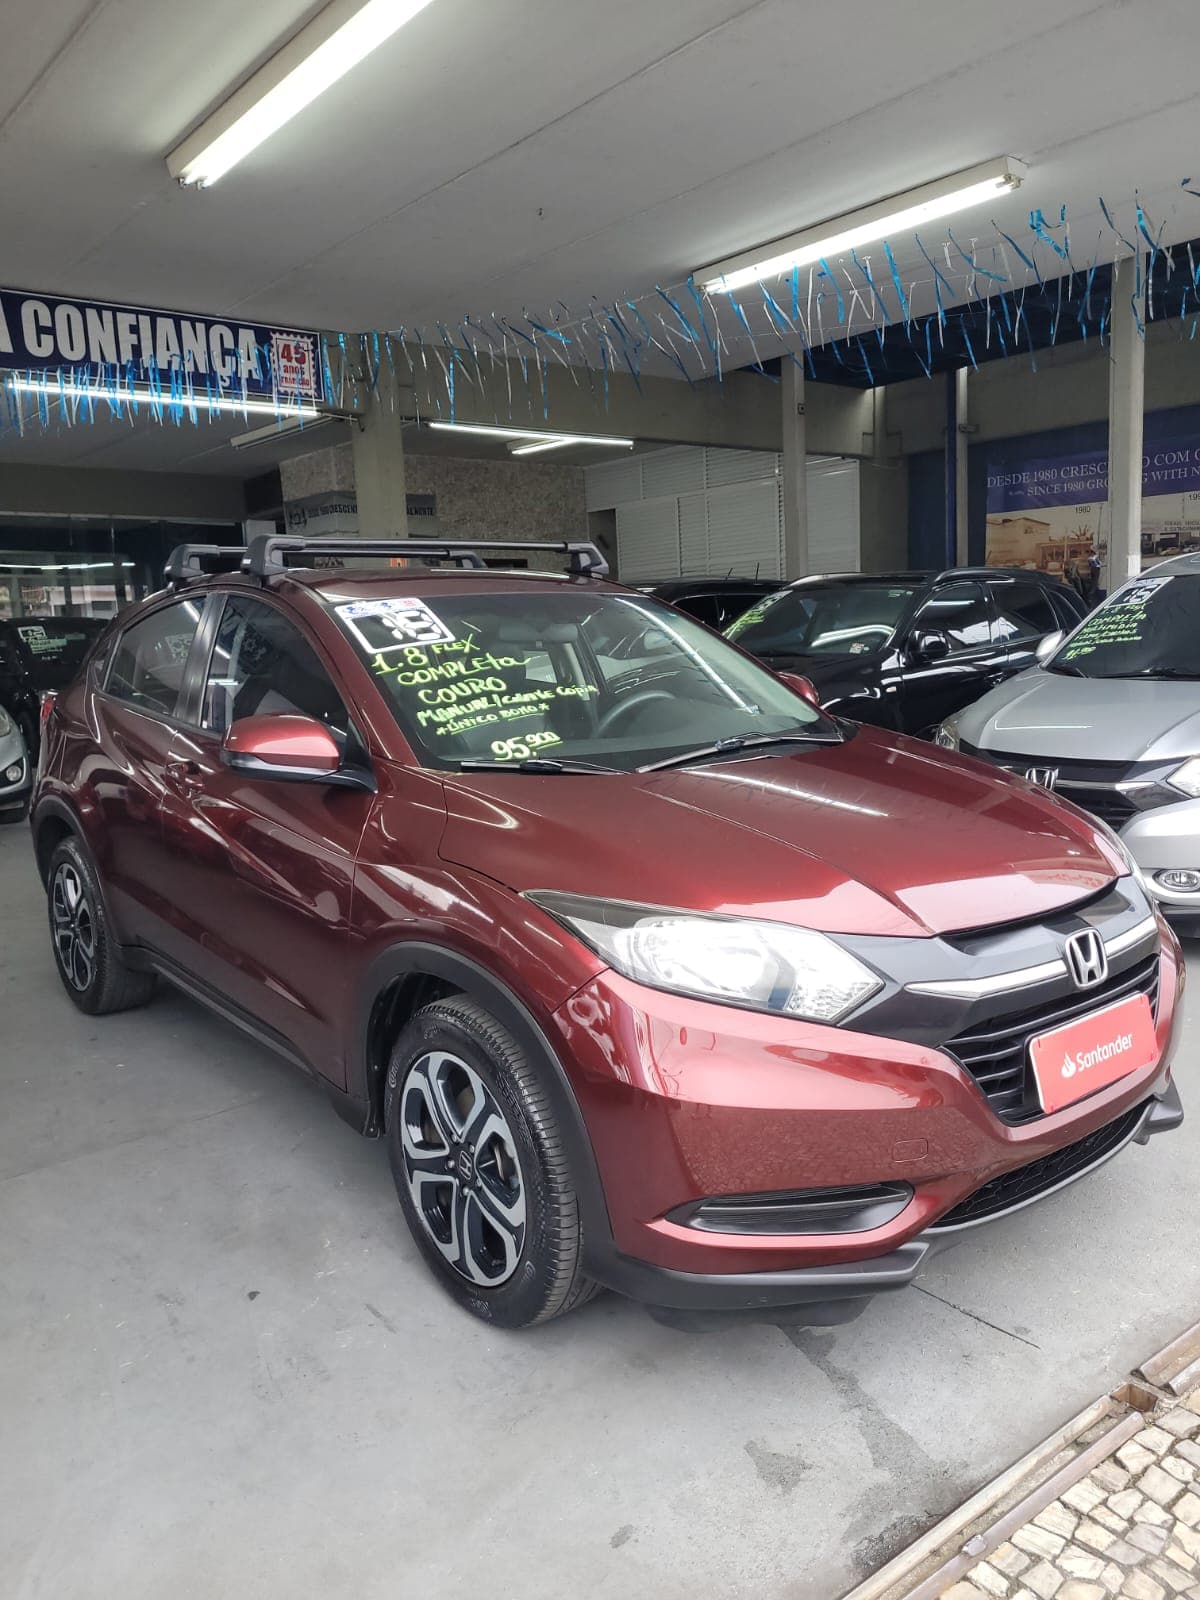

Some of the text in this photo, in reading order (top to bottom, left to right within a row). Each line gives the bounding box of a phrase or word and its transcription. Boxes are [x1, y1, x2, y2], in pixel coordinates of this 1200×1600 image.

[20, 299, 261, 388] CONFIANÇA
[986, 472, 1031, 488] DESDE
[1034, 468, 1058, 482] 1980
[1154, 450, 1189, 466] COM
[1027, 483, 1061, 496] SINCE
[1063, 480, 1085, 493] 1980
[1151, 468, 1188, 481] WITH
[370, 633, 481, 675] 1.8 FLEX
[417, 676, 507, 705] COURO
[1076, 1033, 1134, 1072] Santander
